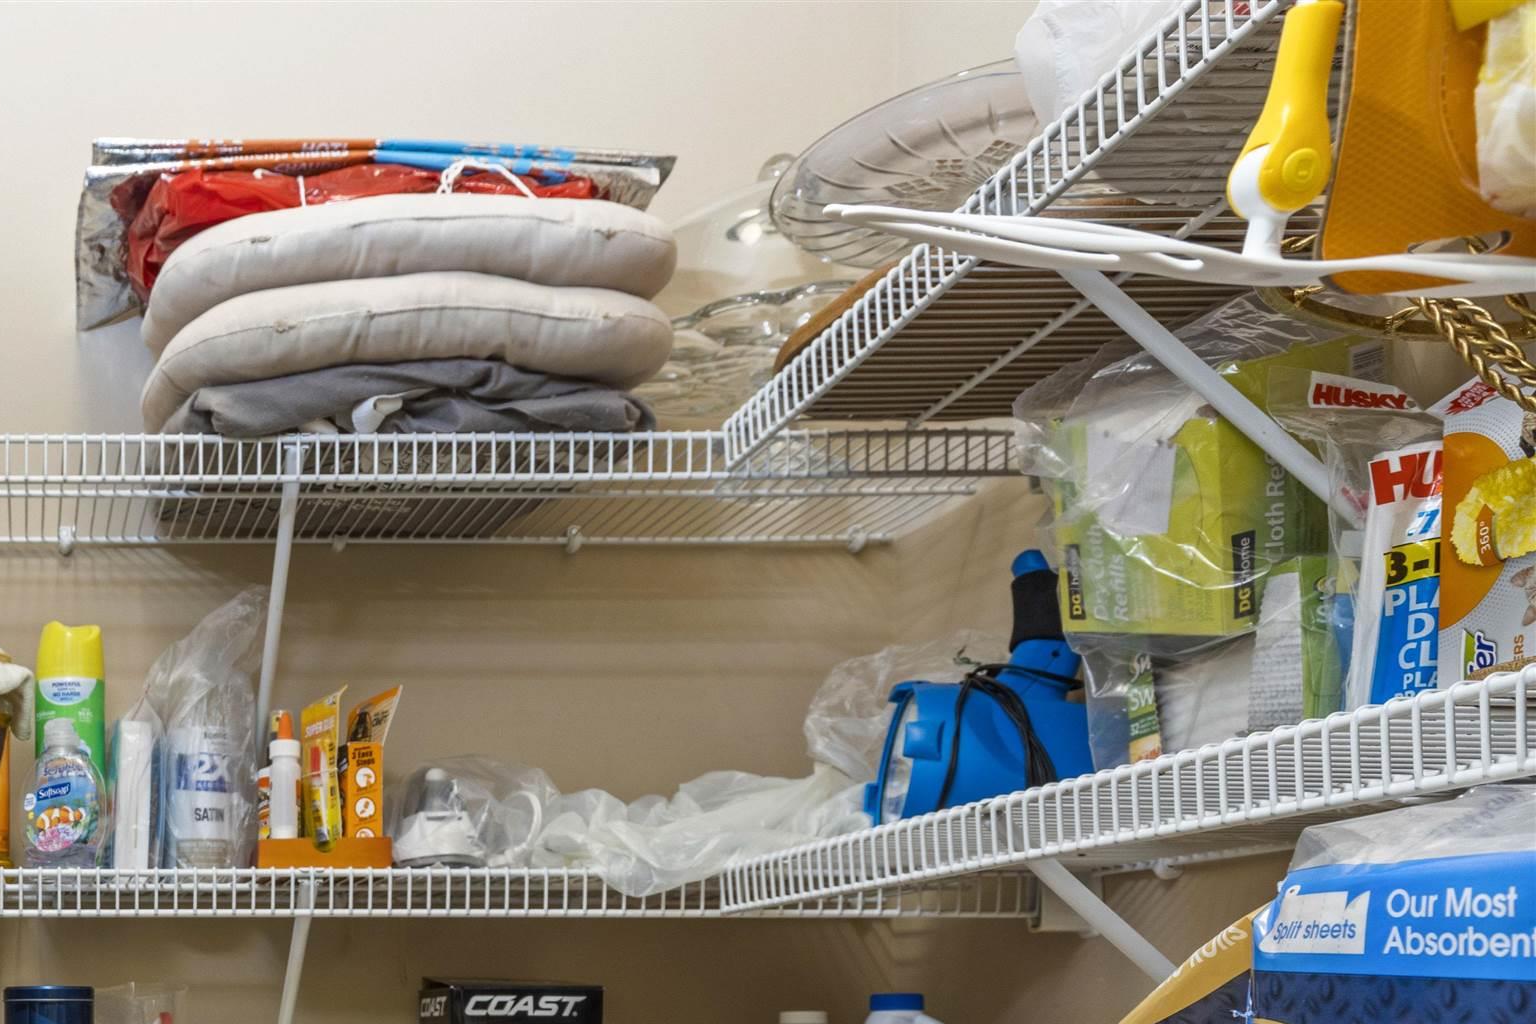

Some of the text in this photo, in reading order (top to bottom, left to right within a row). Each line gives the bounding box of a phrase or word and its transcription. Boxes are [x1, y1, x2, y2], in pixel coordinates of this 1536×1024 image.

[1313, 383, 1408, 409] HUSKY
[1240, 587, 1252, 612] DG
[38, 783, 71, 800] Softsoap
[194, 807, 225, 823] SATIN
[1386, 886, 1519, 918] Our Most
[1273, 918, 1357, 942] Split sheets
[420, 996, 448, 1018] COAST
[465, 995, 587, 1017] COAST
